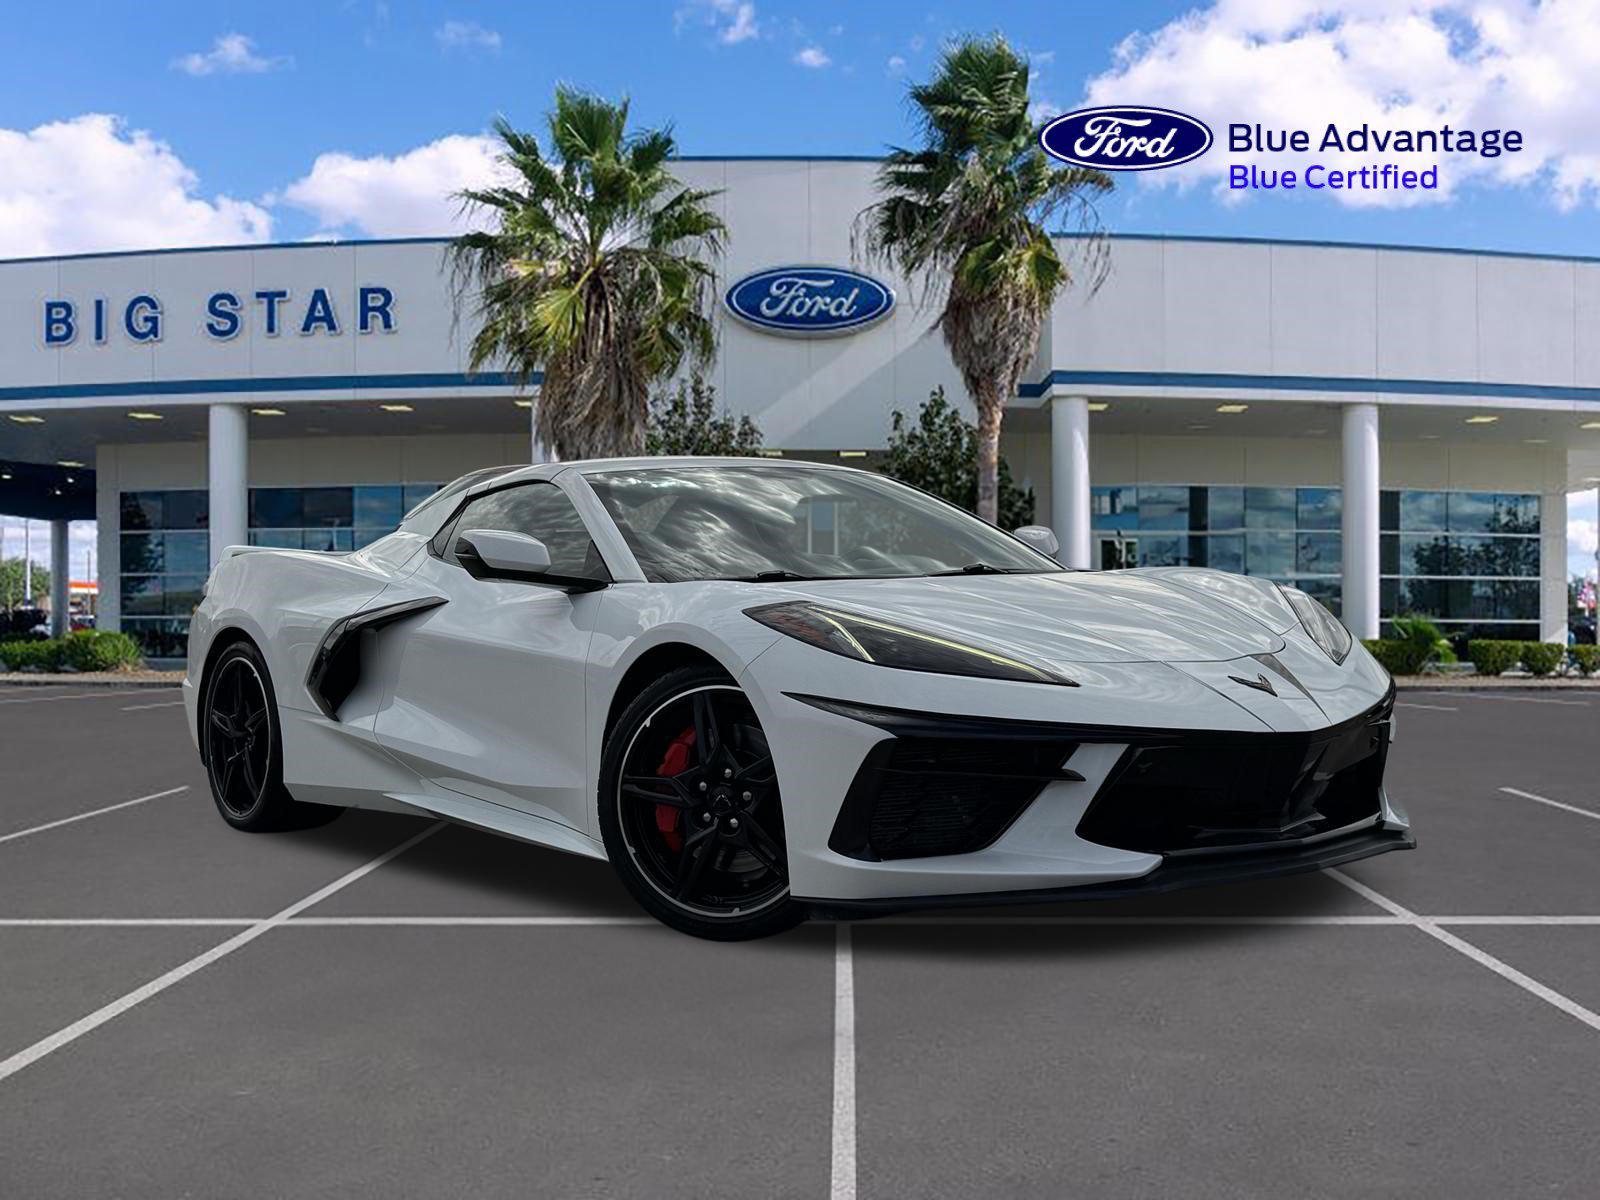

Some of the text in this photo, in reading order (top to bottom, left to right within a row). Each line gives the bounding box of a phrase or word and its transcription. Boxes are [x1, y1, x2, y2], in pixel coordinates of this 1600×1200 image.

[44, 287, 396, 345] BIG STAR
[760, 277, 857, 318] Ford
